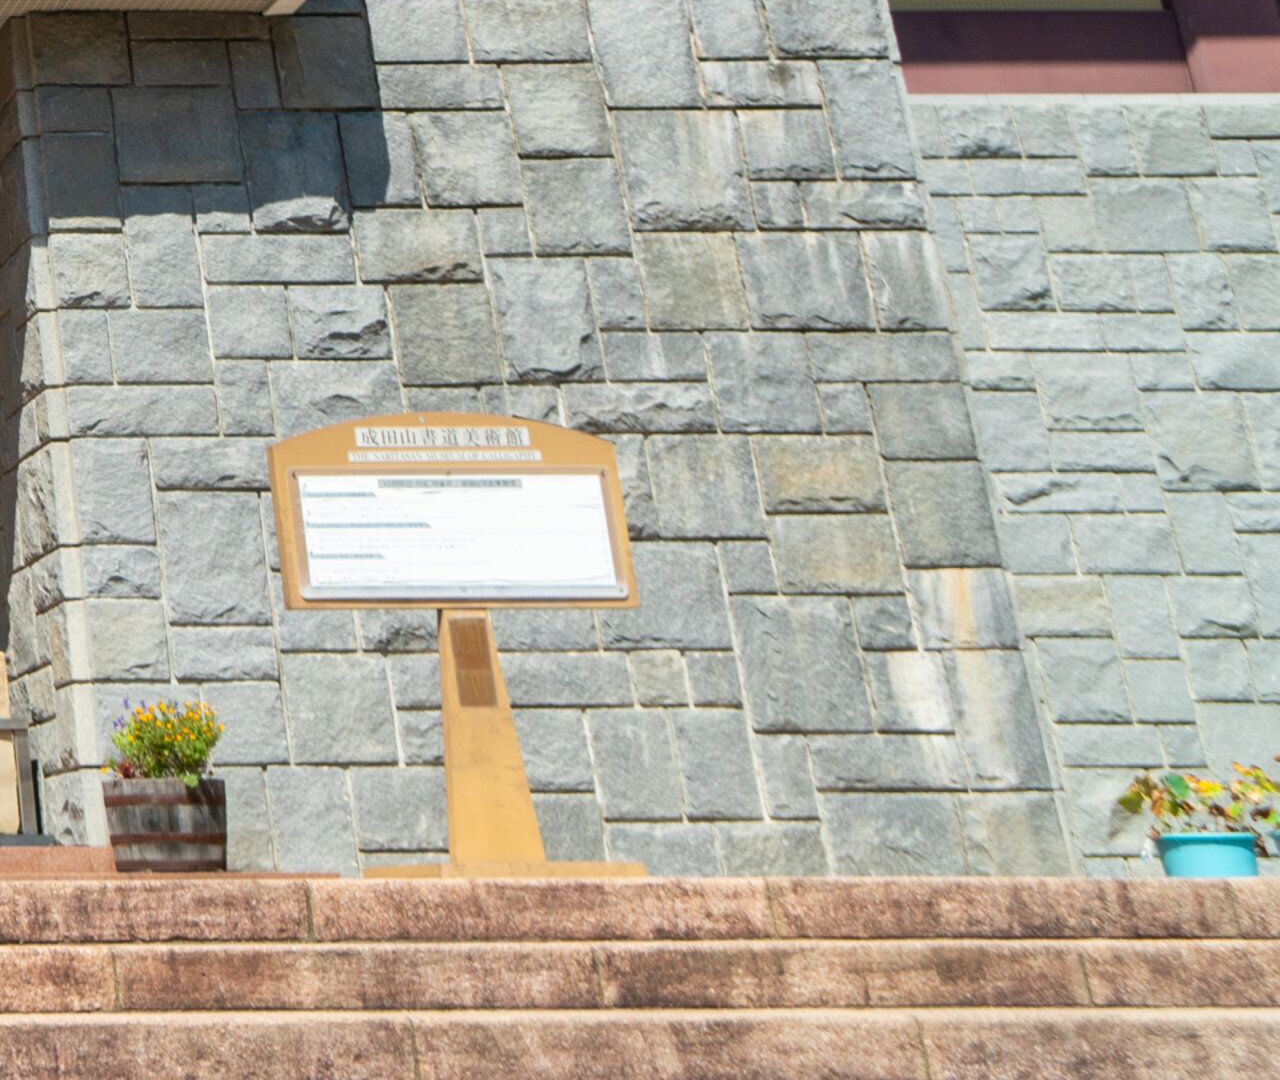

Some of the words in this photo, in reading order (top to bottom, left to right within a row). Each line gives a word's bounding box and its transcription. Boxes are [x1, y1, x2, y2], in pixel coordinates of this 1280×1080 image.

[361, 428, 525, 447] 成田山書道美術館
